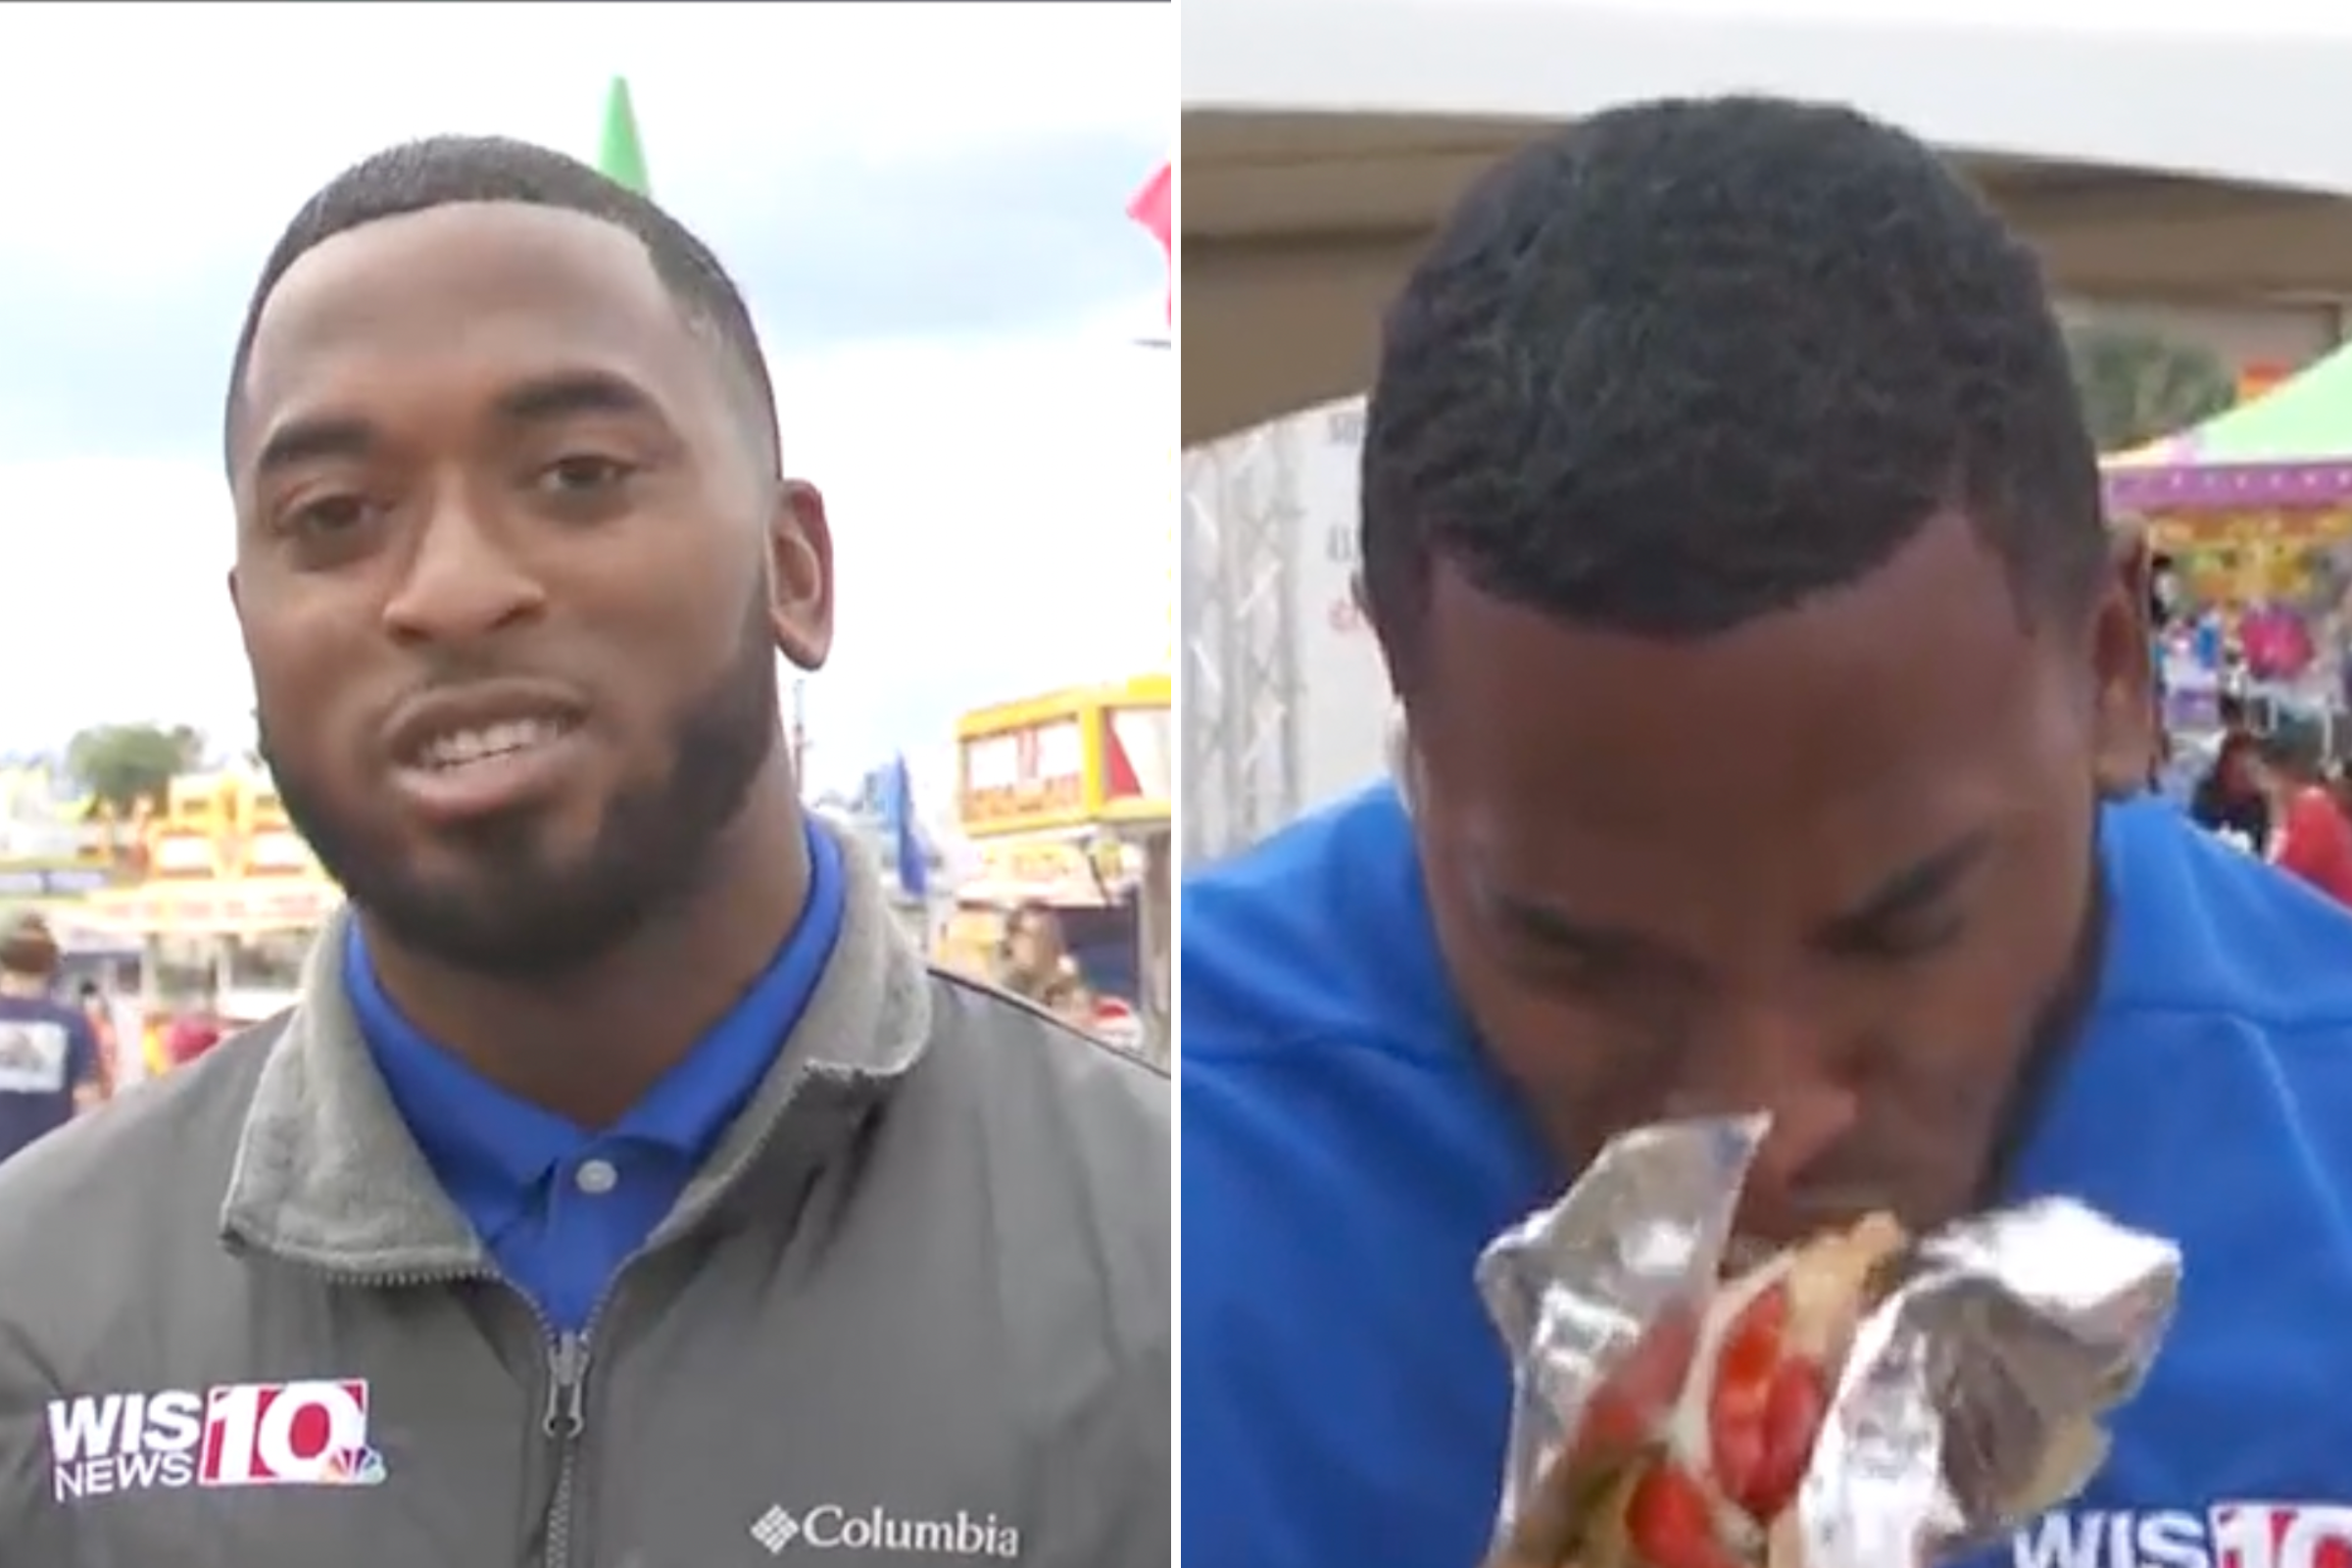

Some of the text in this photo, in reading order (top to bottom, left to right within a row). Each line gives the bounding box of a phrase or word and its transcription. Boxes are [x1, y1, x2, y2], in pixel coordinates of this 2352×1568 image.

[47, 1380, 368, 1484] WIS 10
[53, 1449, 196, 1502] NEWS
[802, 1502, 1020, 1558] Columbia
[2012, 1509, 2211, 1568] WIS
